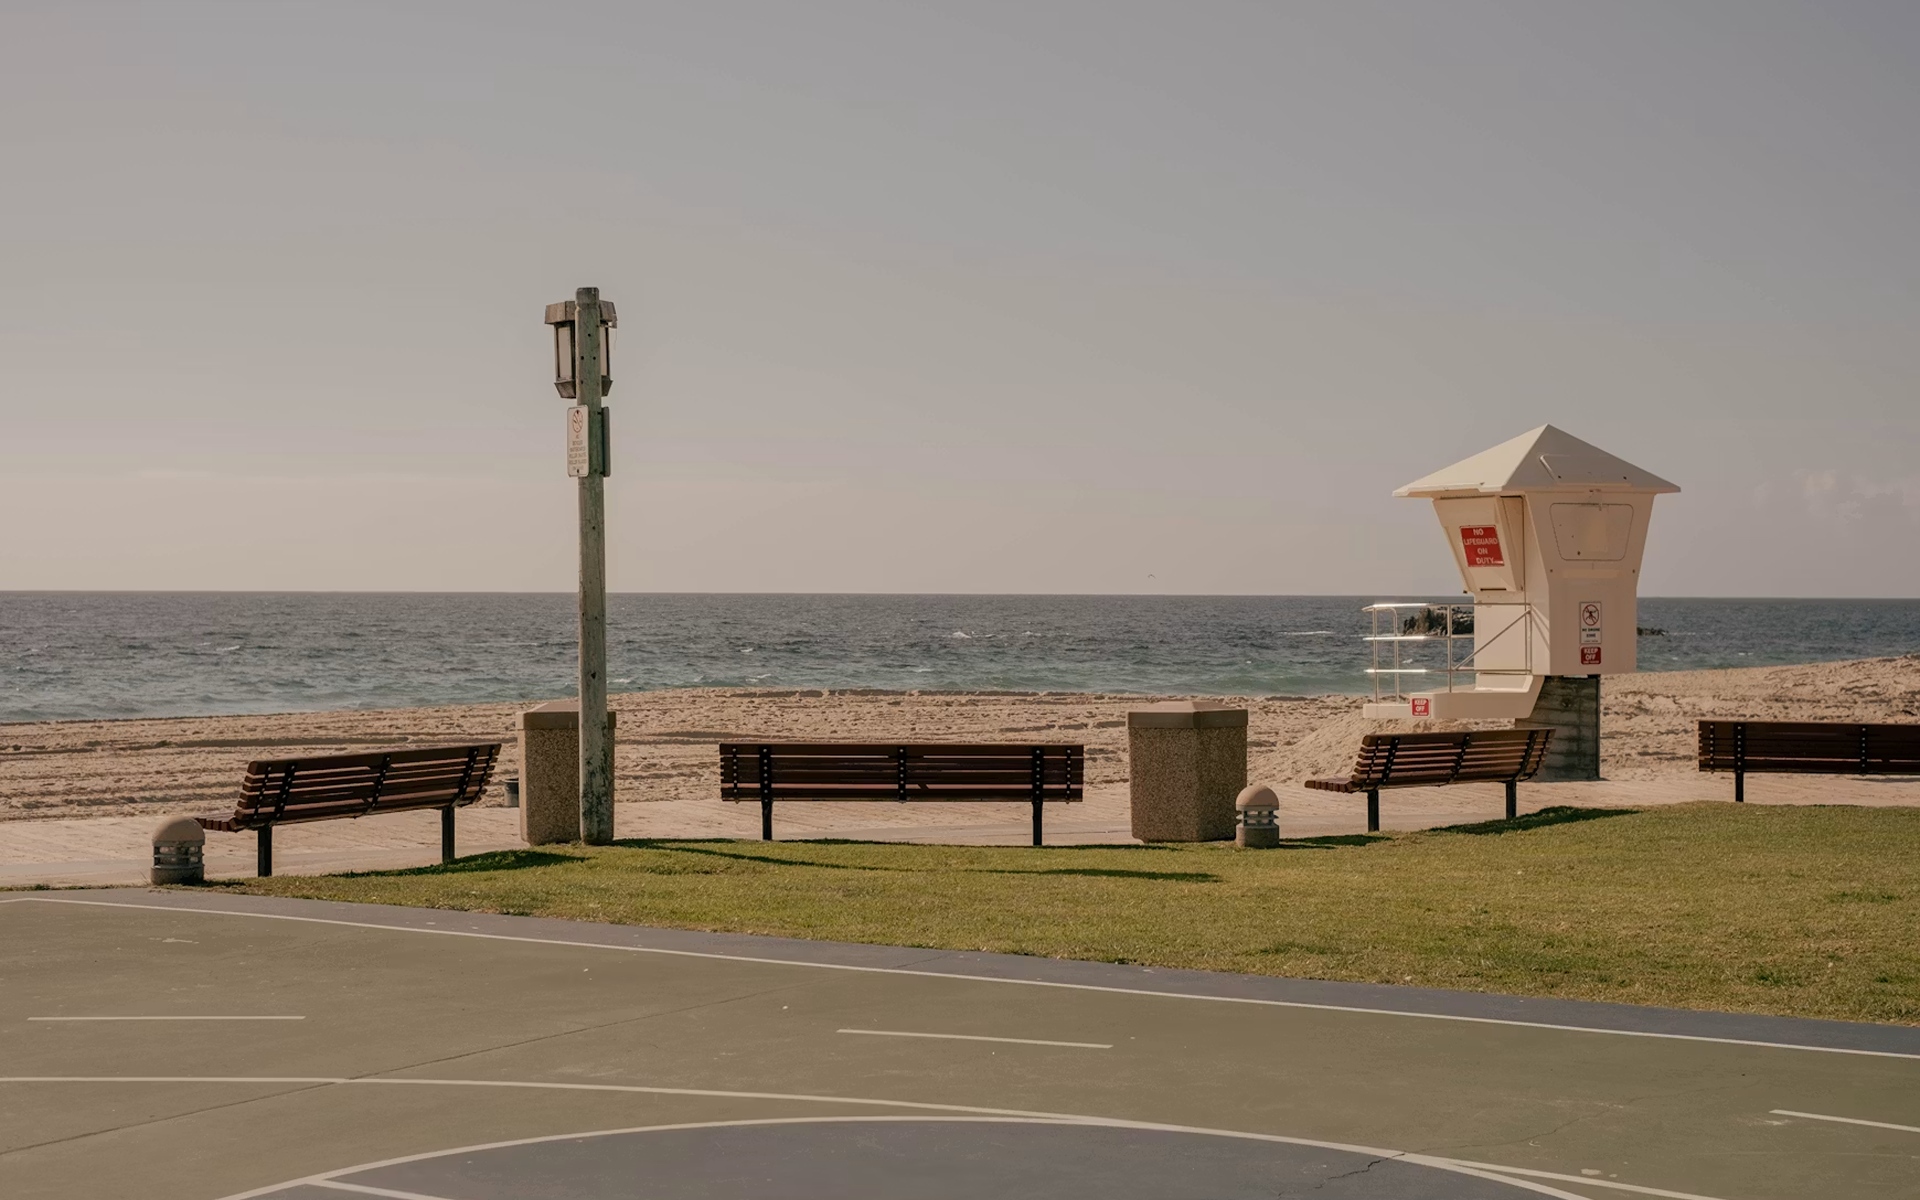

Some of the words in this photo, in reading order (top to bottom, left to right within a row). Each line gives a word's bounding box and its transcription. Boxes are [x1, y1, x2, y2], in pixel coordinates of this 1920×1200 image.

[1473, 528, 1484, 536] NO
[1463, 537, 1498, 546] LIFEGUARD
[1475, 557, 1494, 565] DUTY
